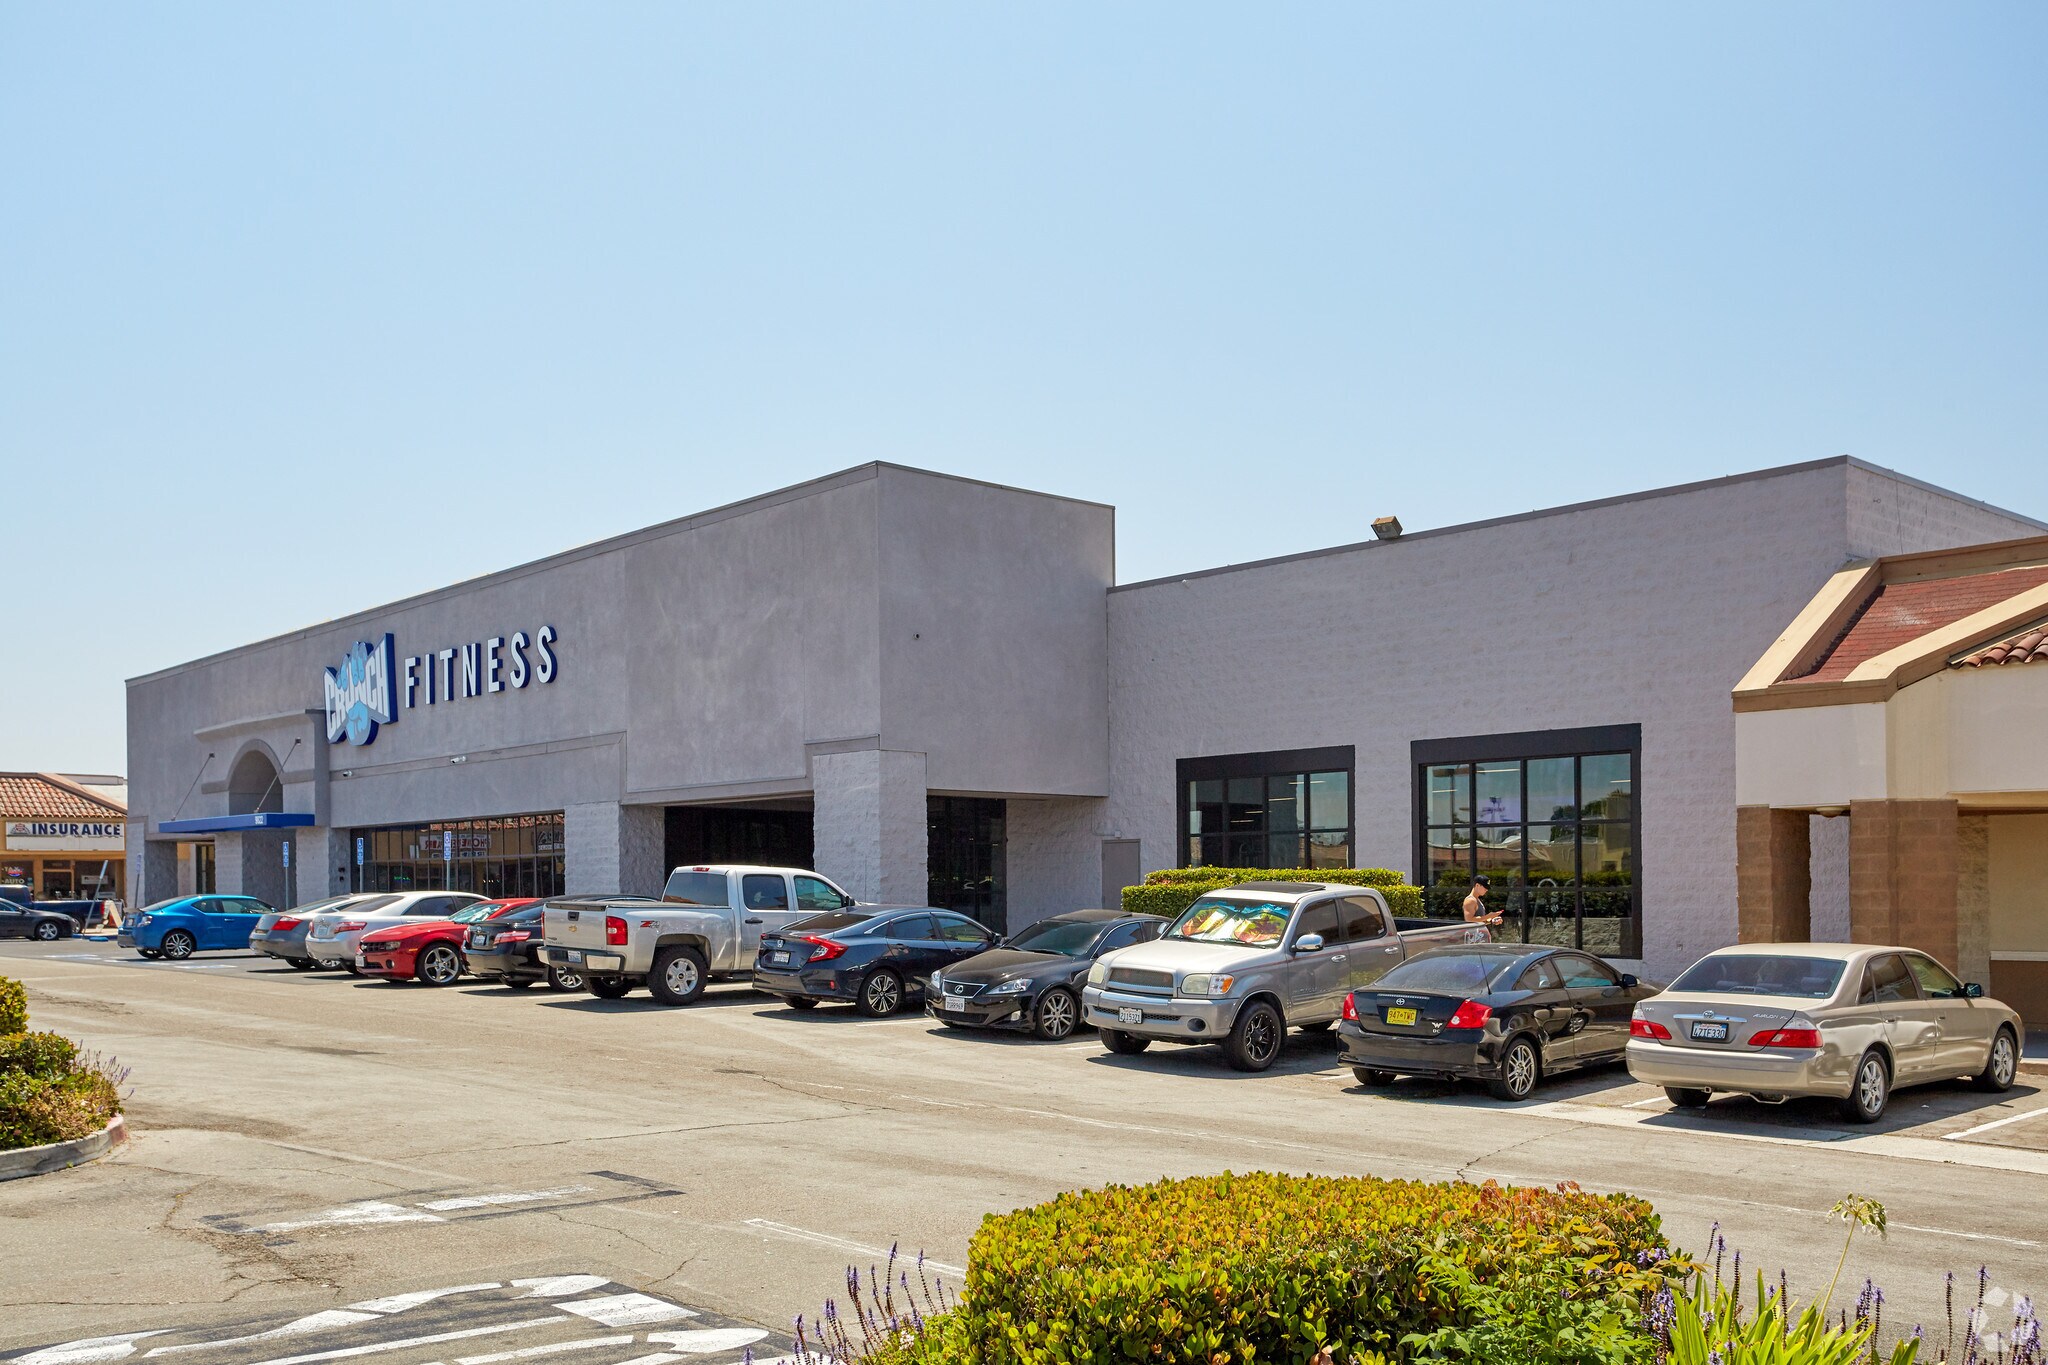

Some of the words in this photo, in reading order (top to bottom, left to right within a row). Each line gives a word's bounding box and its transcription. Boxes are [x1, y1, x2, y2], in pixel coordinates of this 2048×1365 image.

[324, 639, 389, 740] CRUNCH
[405, 626, 557, 708] FITNESS
[32, 823, 120, 835] INSURANCE
